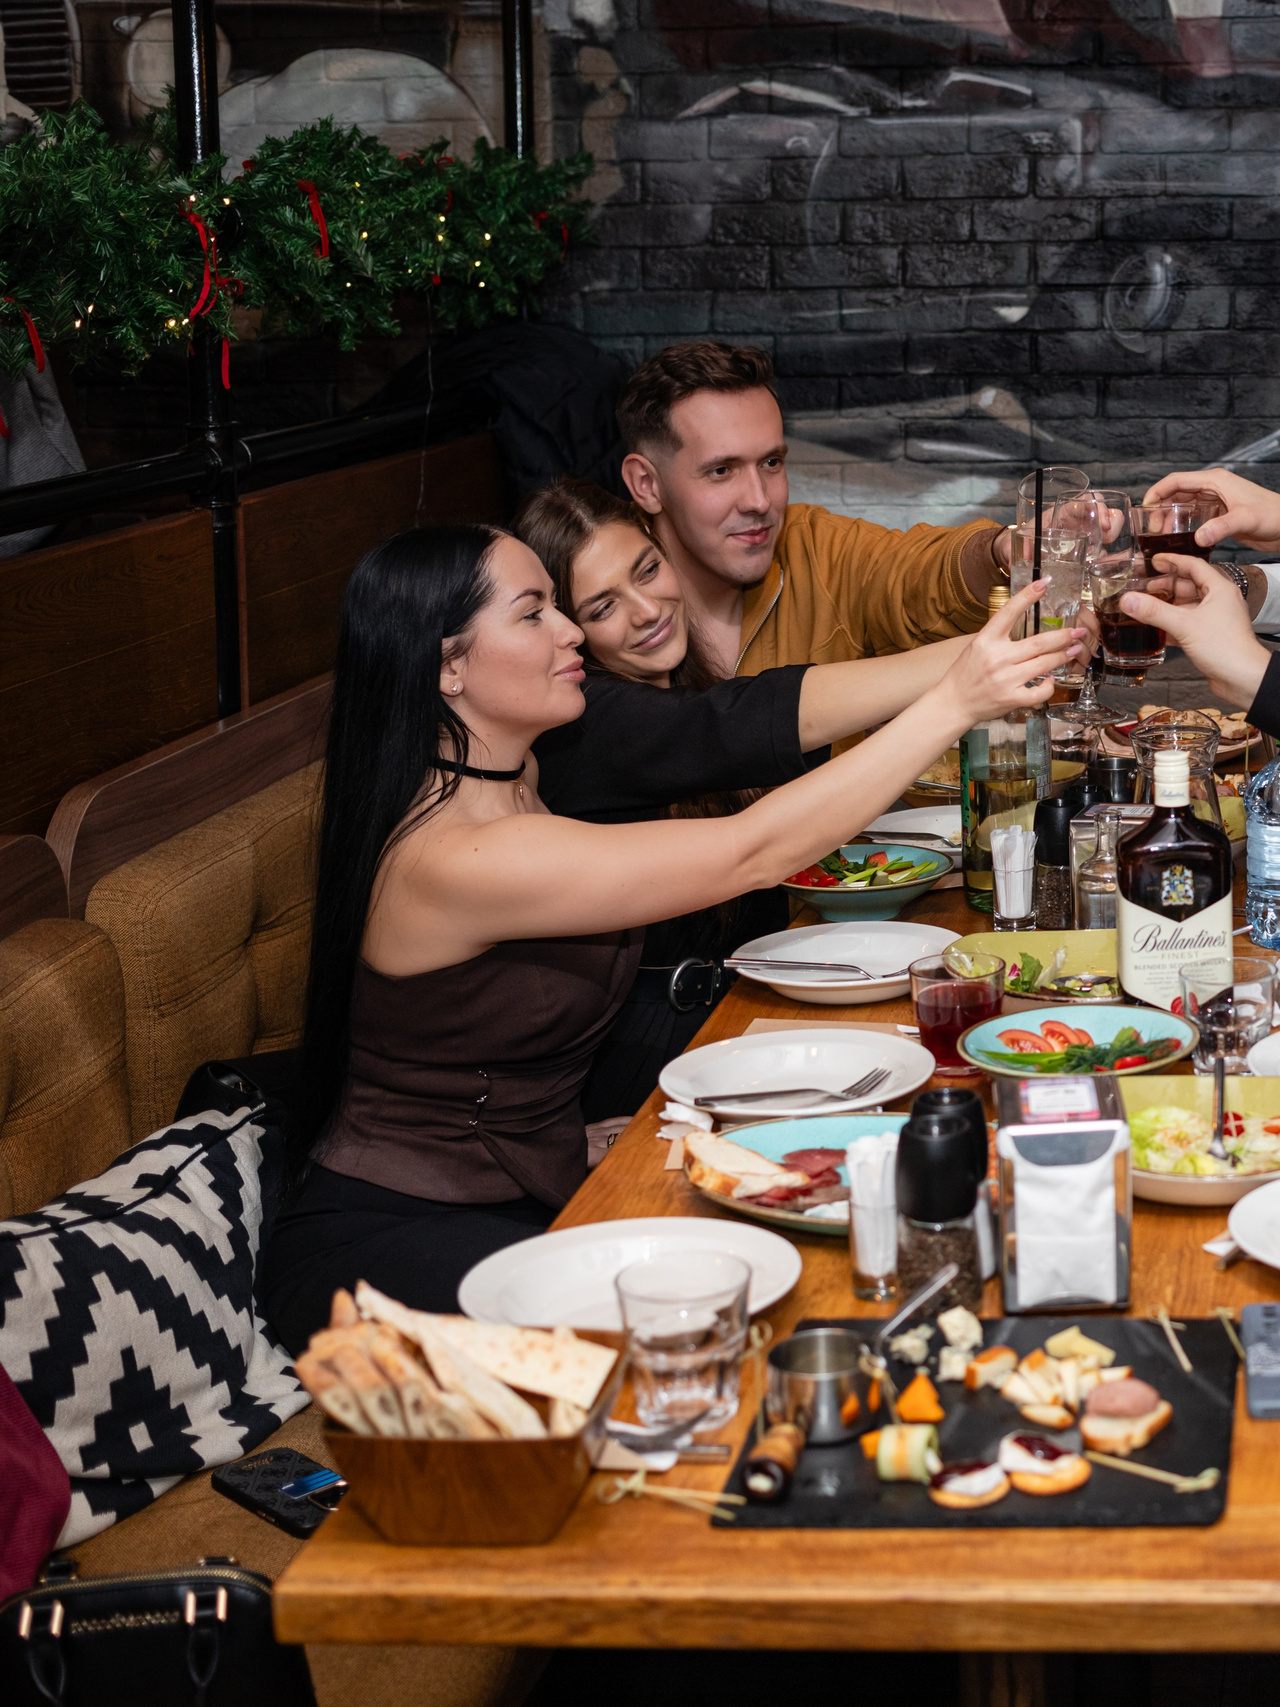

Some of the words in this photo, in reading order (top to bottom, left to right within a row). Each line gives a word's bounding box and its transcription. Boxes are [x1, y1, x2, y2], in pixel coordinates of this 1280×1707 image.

[1131, 923, 1227, 953] Ballantine's
[1161, 951, 1200, 960] FINEST
[1134, 962, 1167, 971] BLENDED
